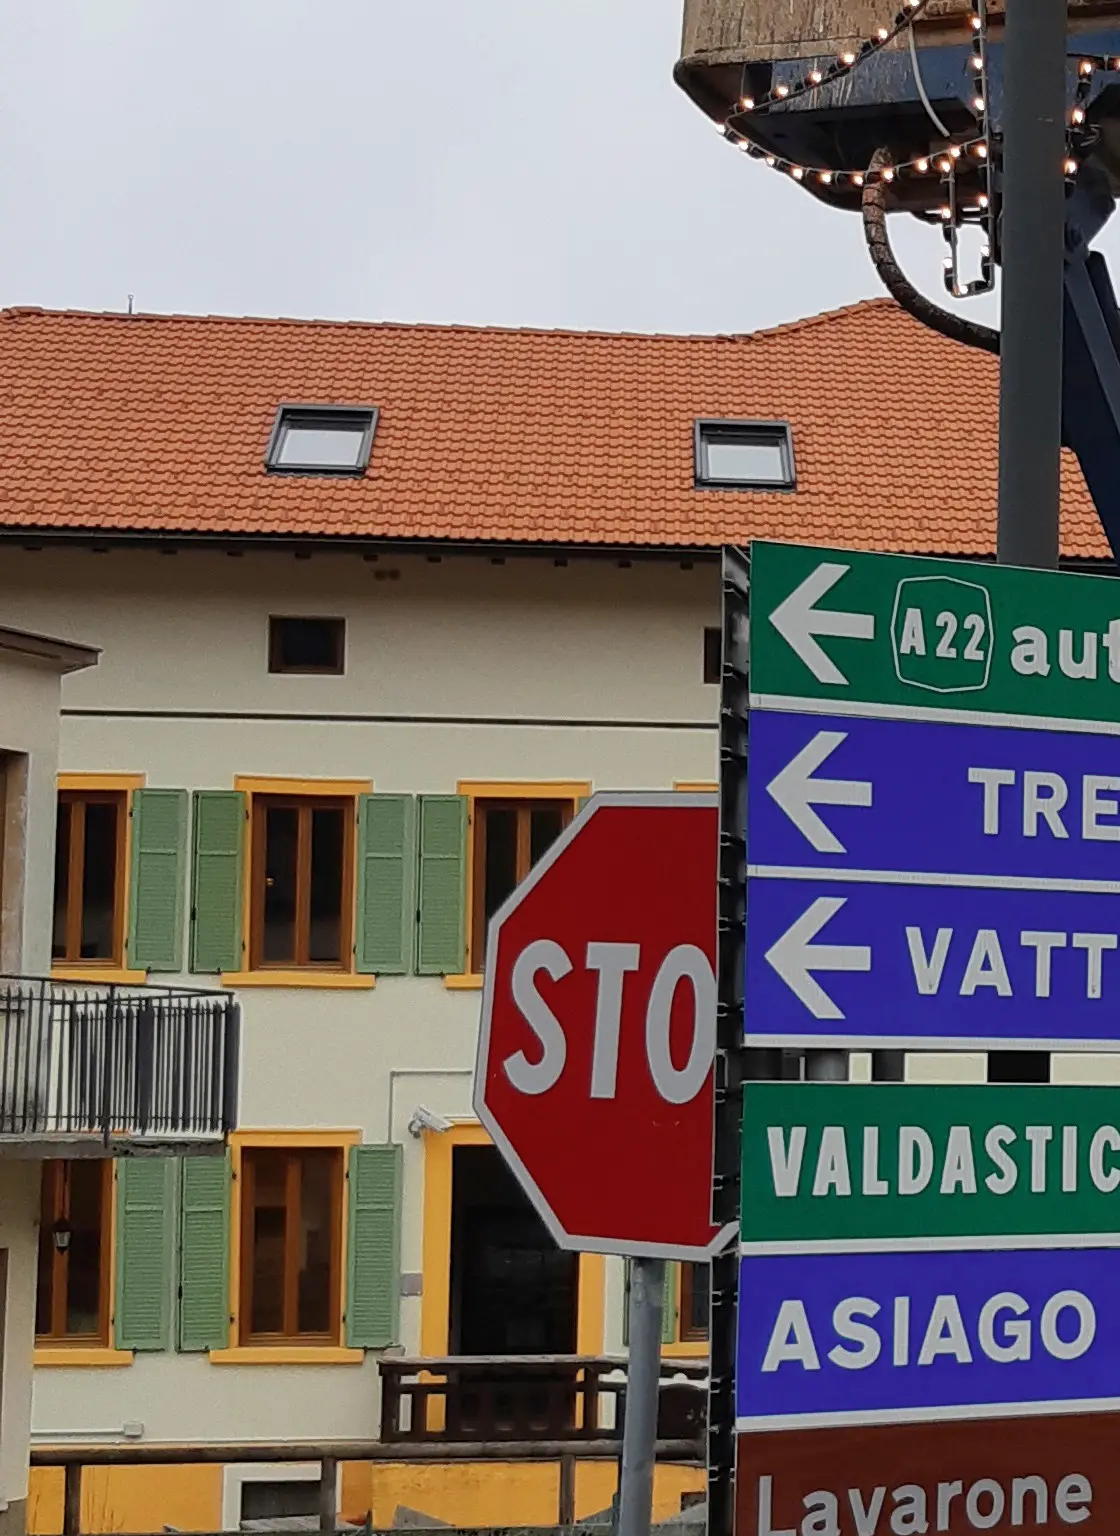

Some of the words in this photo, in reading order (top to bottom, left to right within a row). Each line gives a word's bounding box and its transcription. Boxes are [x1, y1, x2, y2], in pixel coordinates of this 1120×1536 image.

[900, 607, 986, 662] A22
[503, 939, 717, 1104] STO
[761, 1289, 1096, 1372] ASIAGO
